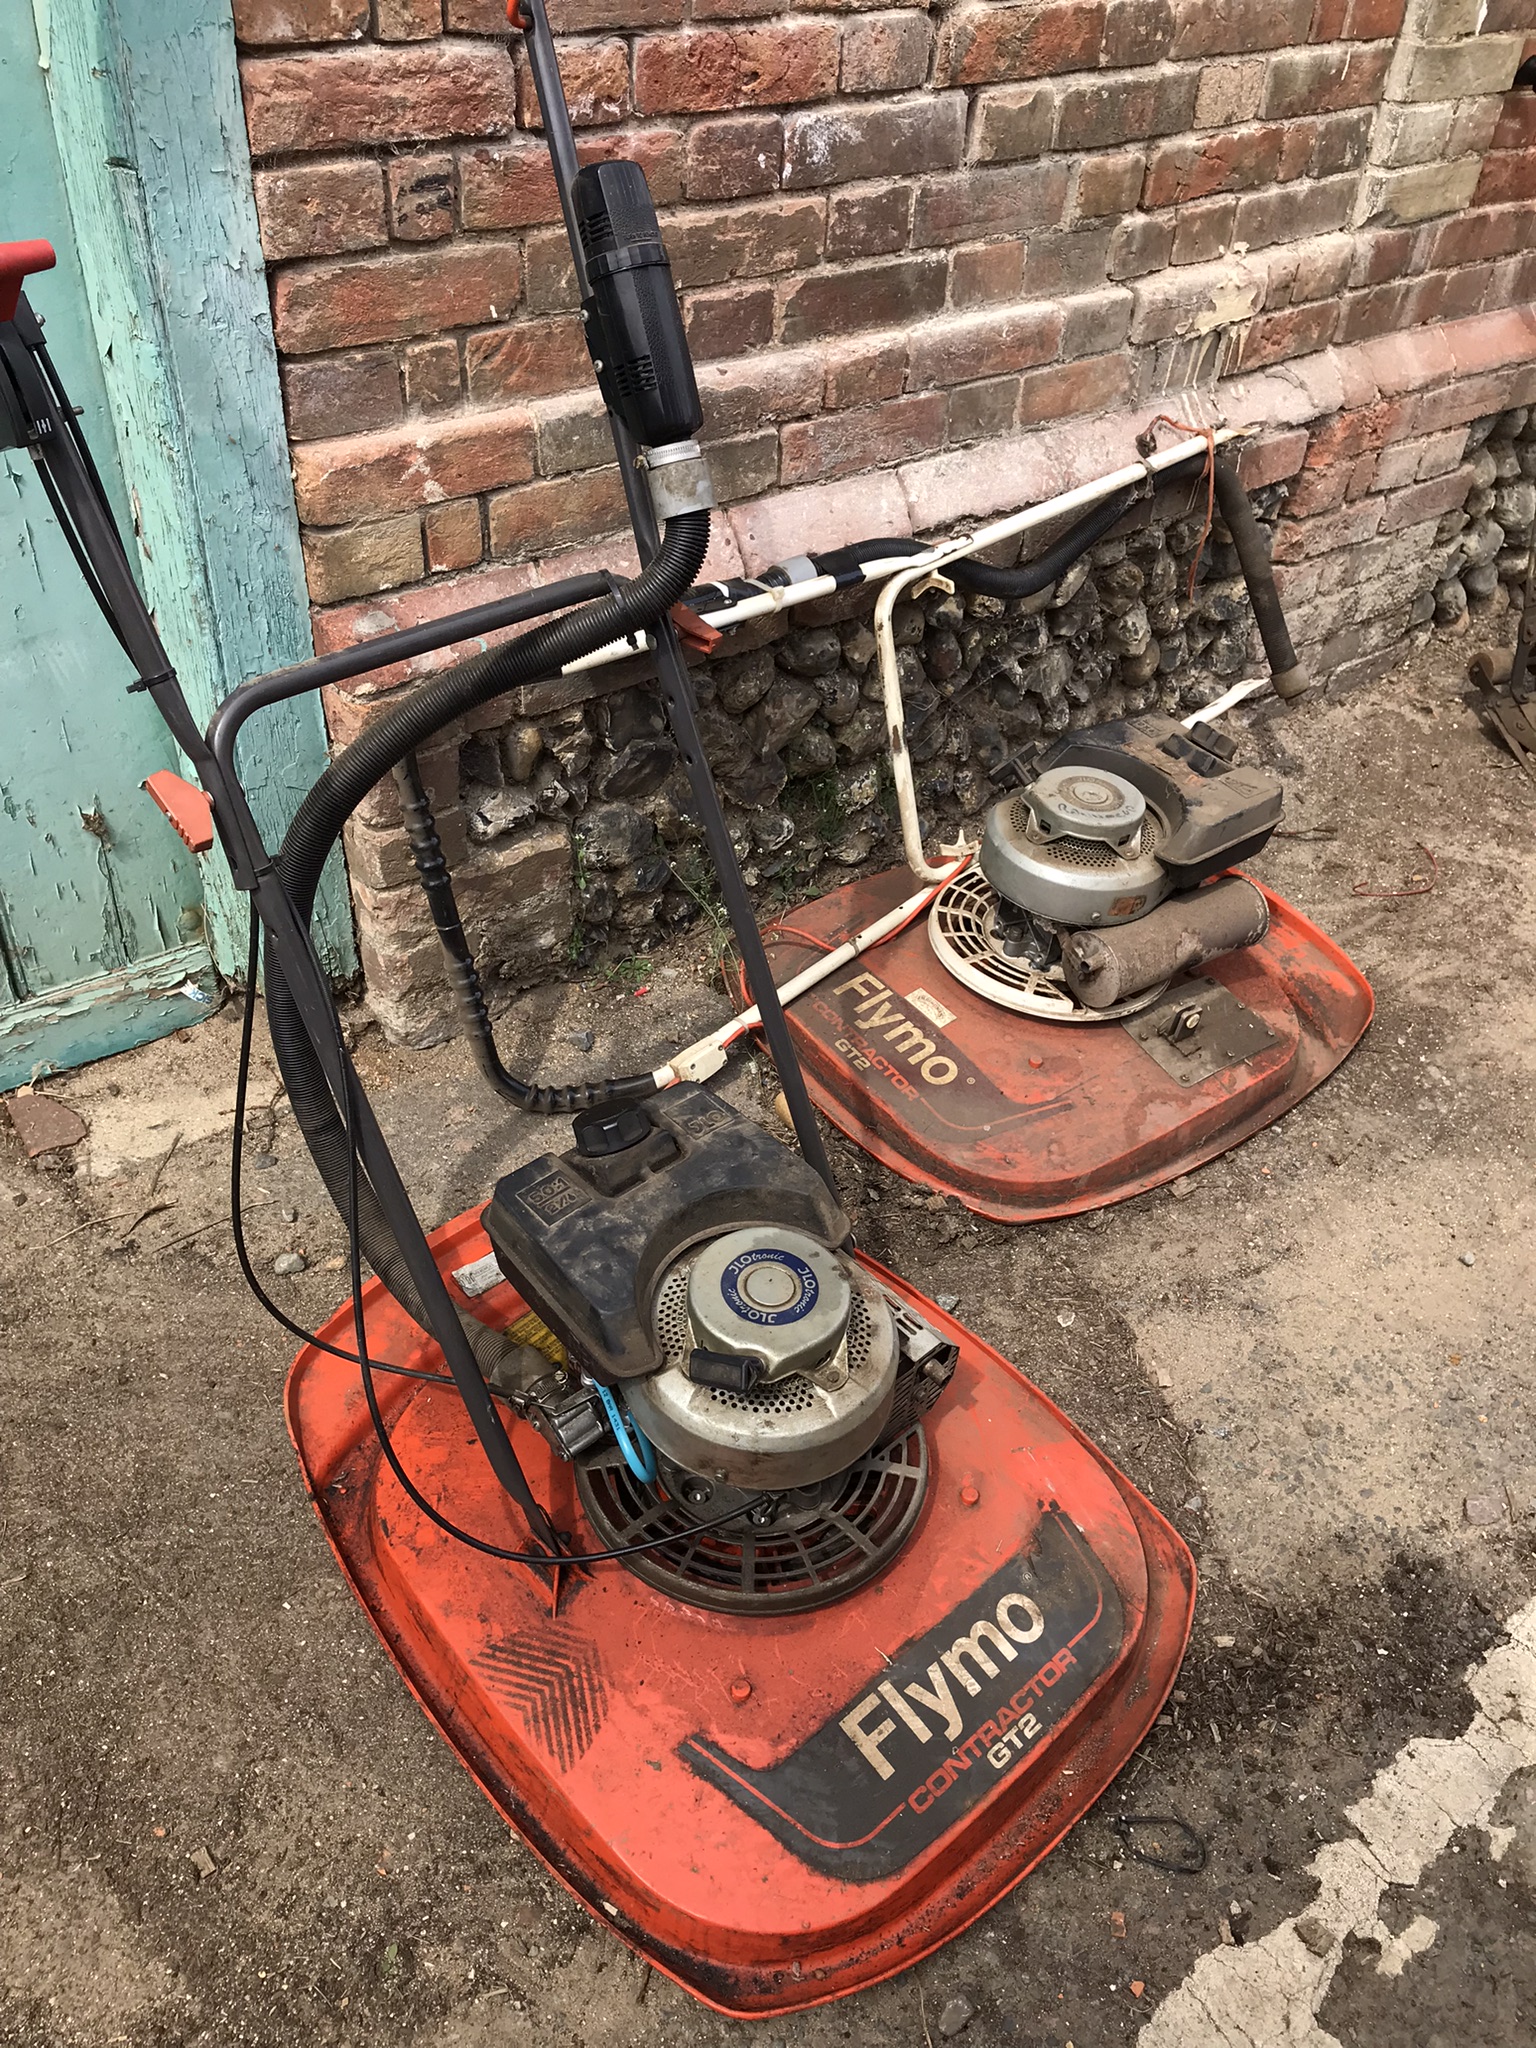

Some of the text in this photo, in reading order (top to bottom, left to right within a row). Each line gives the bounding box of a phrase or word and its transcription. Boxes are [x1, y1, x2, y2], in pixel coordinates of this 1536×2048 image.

[811, 1000, 920, 1101] CONTRACTOR
[832, 972, 958, 1085] Flymo
[834, 1038, 871, 1071] GT2
[728, 1252, 785, 1275] JLOtronic
[794, 1266, 817, 1314] JLOtronic
[727, 1287, 778, 1324] JLOtronic
[838, 1593, 1045, 1781] Flymo
[908, 1647, 1078, 1815] CONTRACTOR
[986, 1712, 1043, 1769] GT2
